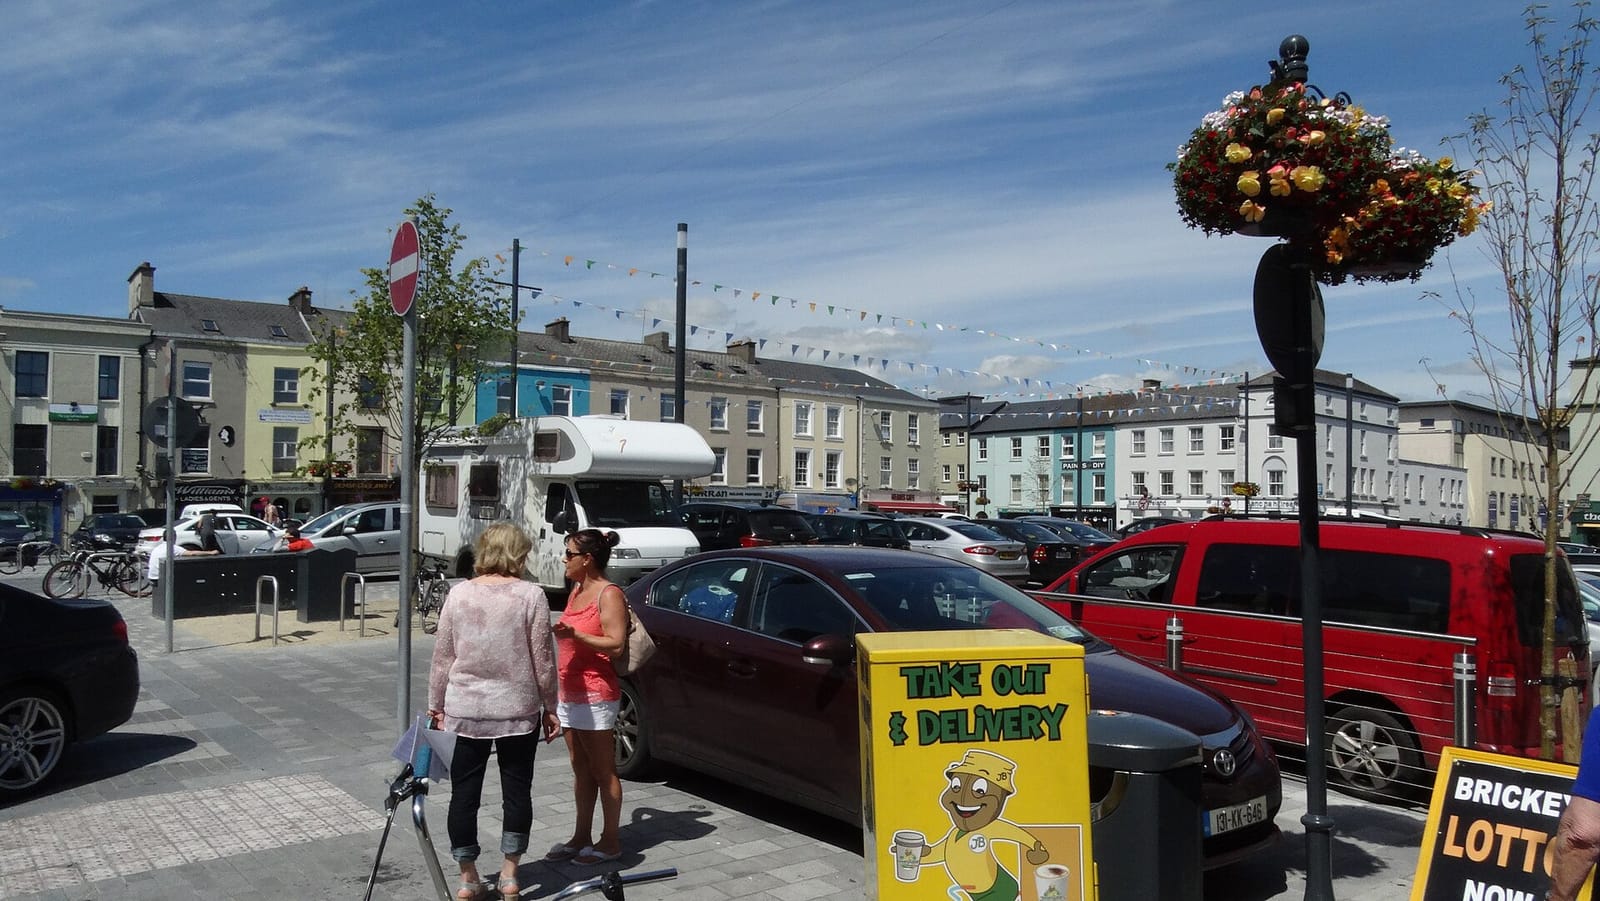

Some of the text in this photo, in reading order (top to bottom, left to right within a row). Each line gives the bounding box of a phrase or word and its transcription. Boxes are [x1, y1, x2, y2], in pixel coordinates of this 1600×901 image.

[900, 661, 1050, 699] TAKE OUT
[889, 711, 909, 746] &
[996, 772, 1008, 781] JB
[971, 836, 986, 850] JB
[1463, 879, 1535, 901] NOW
